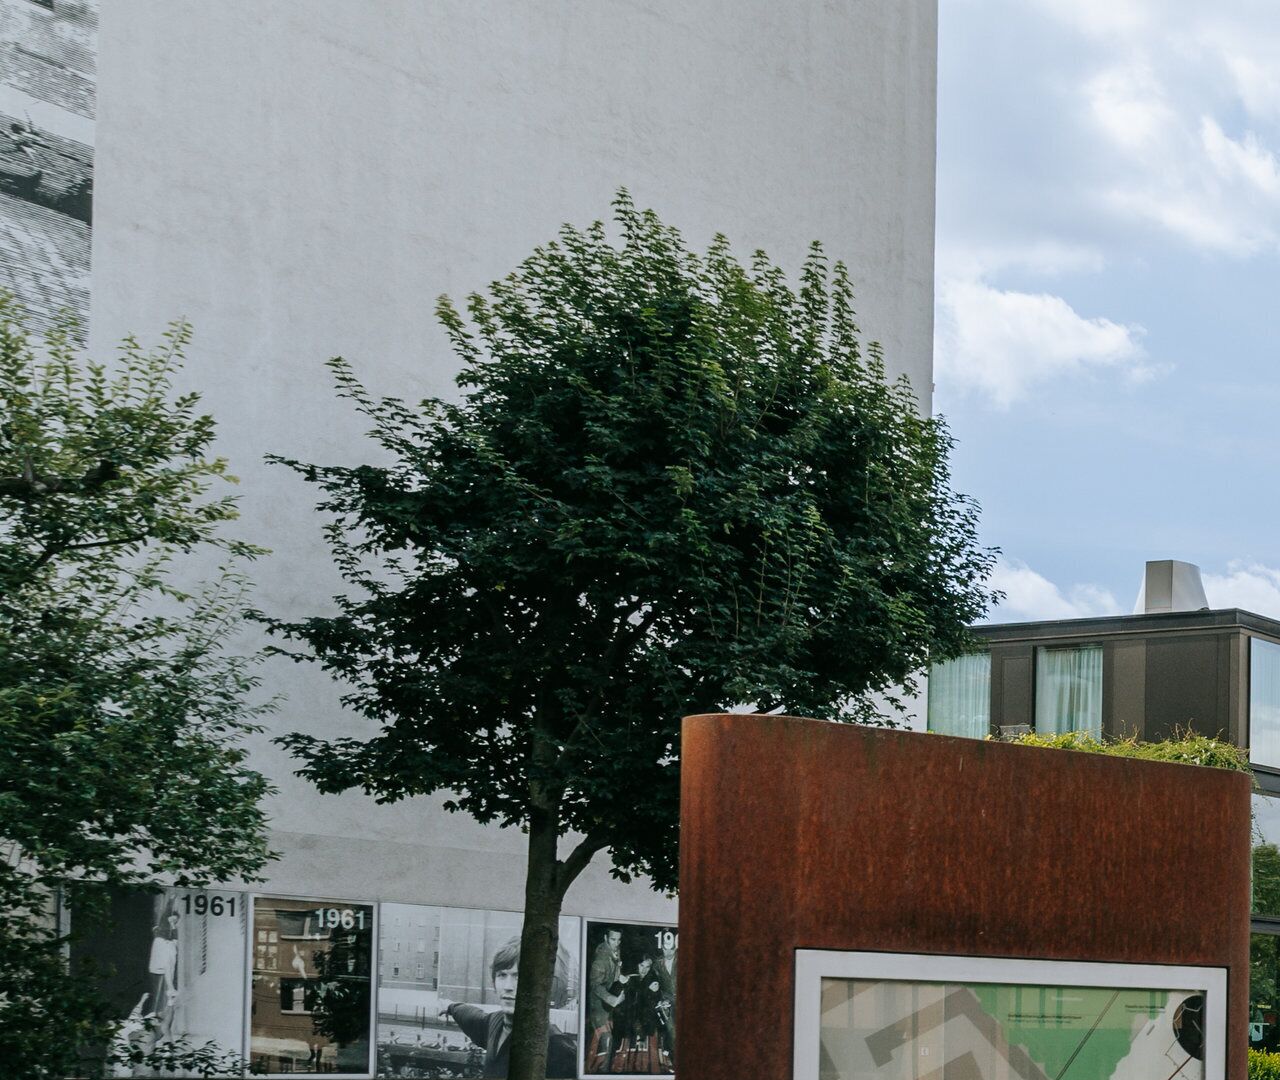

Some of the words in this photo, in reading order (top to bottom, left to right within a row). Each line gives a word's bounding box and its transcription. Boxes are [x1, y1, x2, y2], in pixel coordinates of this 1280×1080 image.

[181, 894, 236, 917] 1961
[315, 907, 365, 930] 1961
[655, 931, 679, 950] 19
